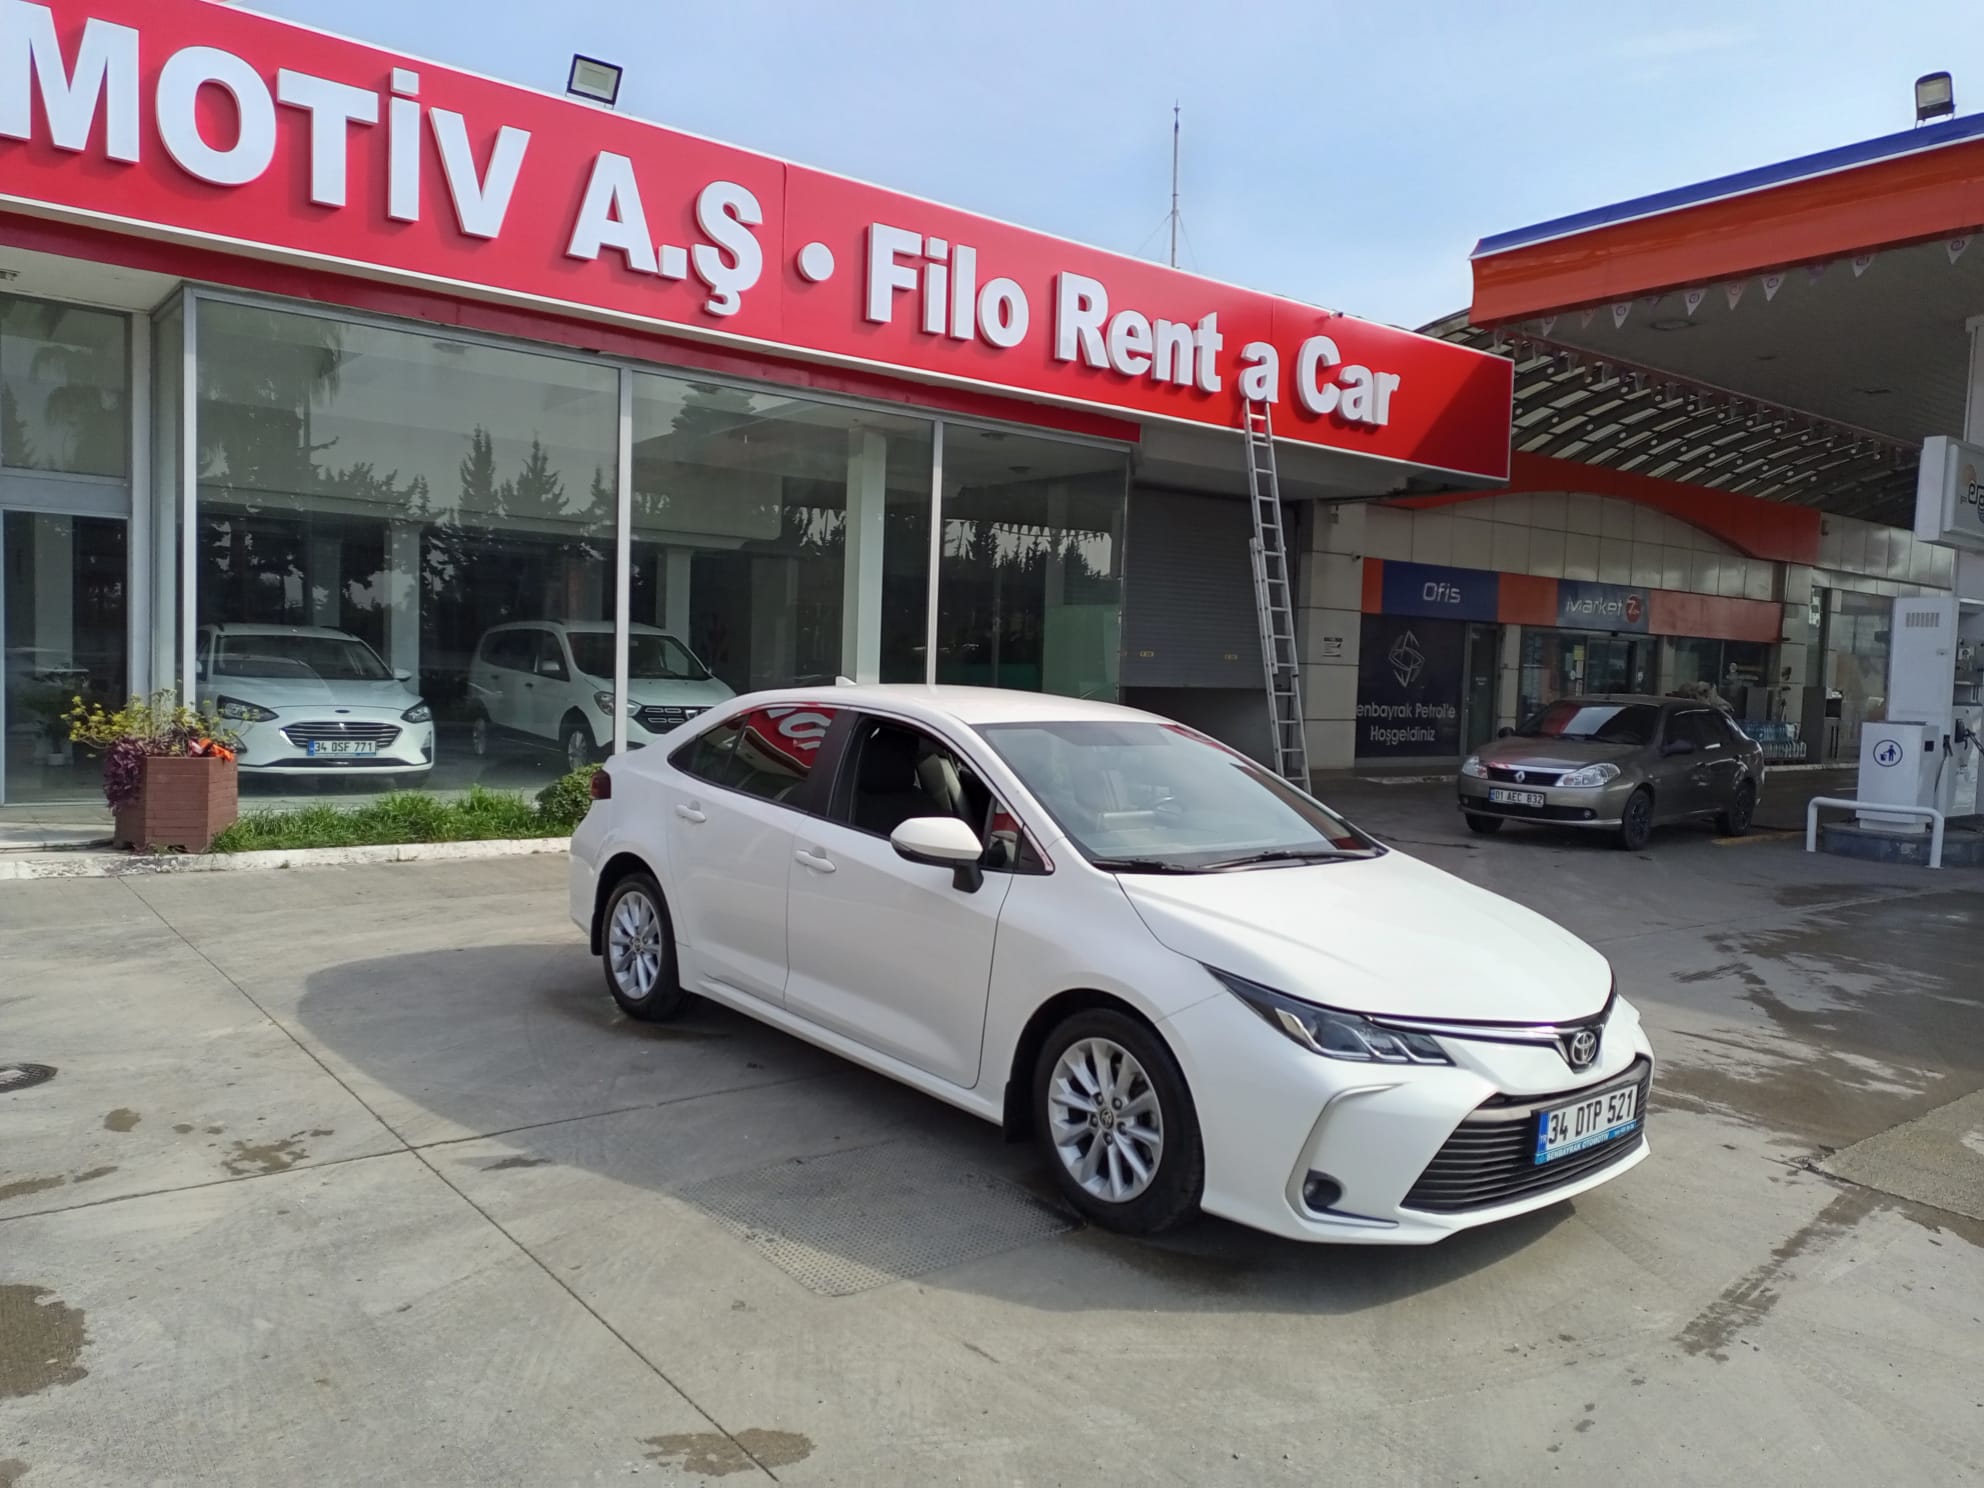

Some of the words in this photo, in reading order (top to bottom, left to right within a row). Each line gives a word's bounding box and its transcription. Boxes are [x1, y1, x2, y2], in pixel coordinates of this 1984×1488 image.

[0, 0, 532, 240] MOTİV
[867, 222, 1029, 348] Filo
[1054, 270, 1223, 393] Rent
[1239, 341, 1279, 404] a
[1297, 335, 1400, 426] Car
[1422, 582, 1461, 604] Ofis
[1565, 597, 1623, 617] Market
[1415, 703, 1456, 719] Petrol'e
[1370, 725, 1436, 746] Hoşgeldiniz
[314, 742, 327, 752] 34
[354, 742, 373, 752] 771
[1548, 1111, 1568, 1145] 34
[1575, 1100, 1602, 1137] DTP
[1607, 1089, 1634, 1124] 521
